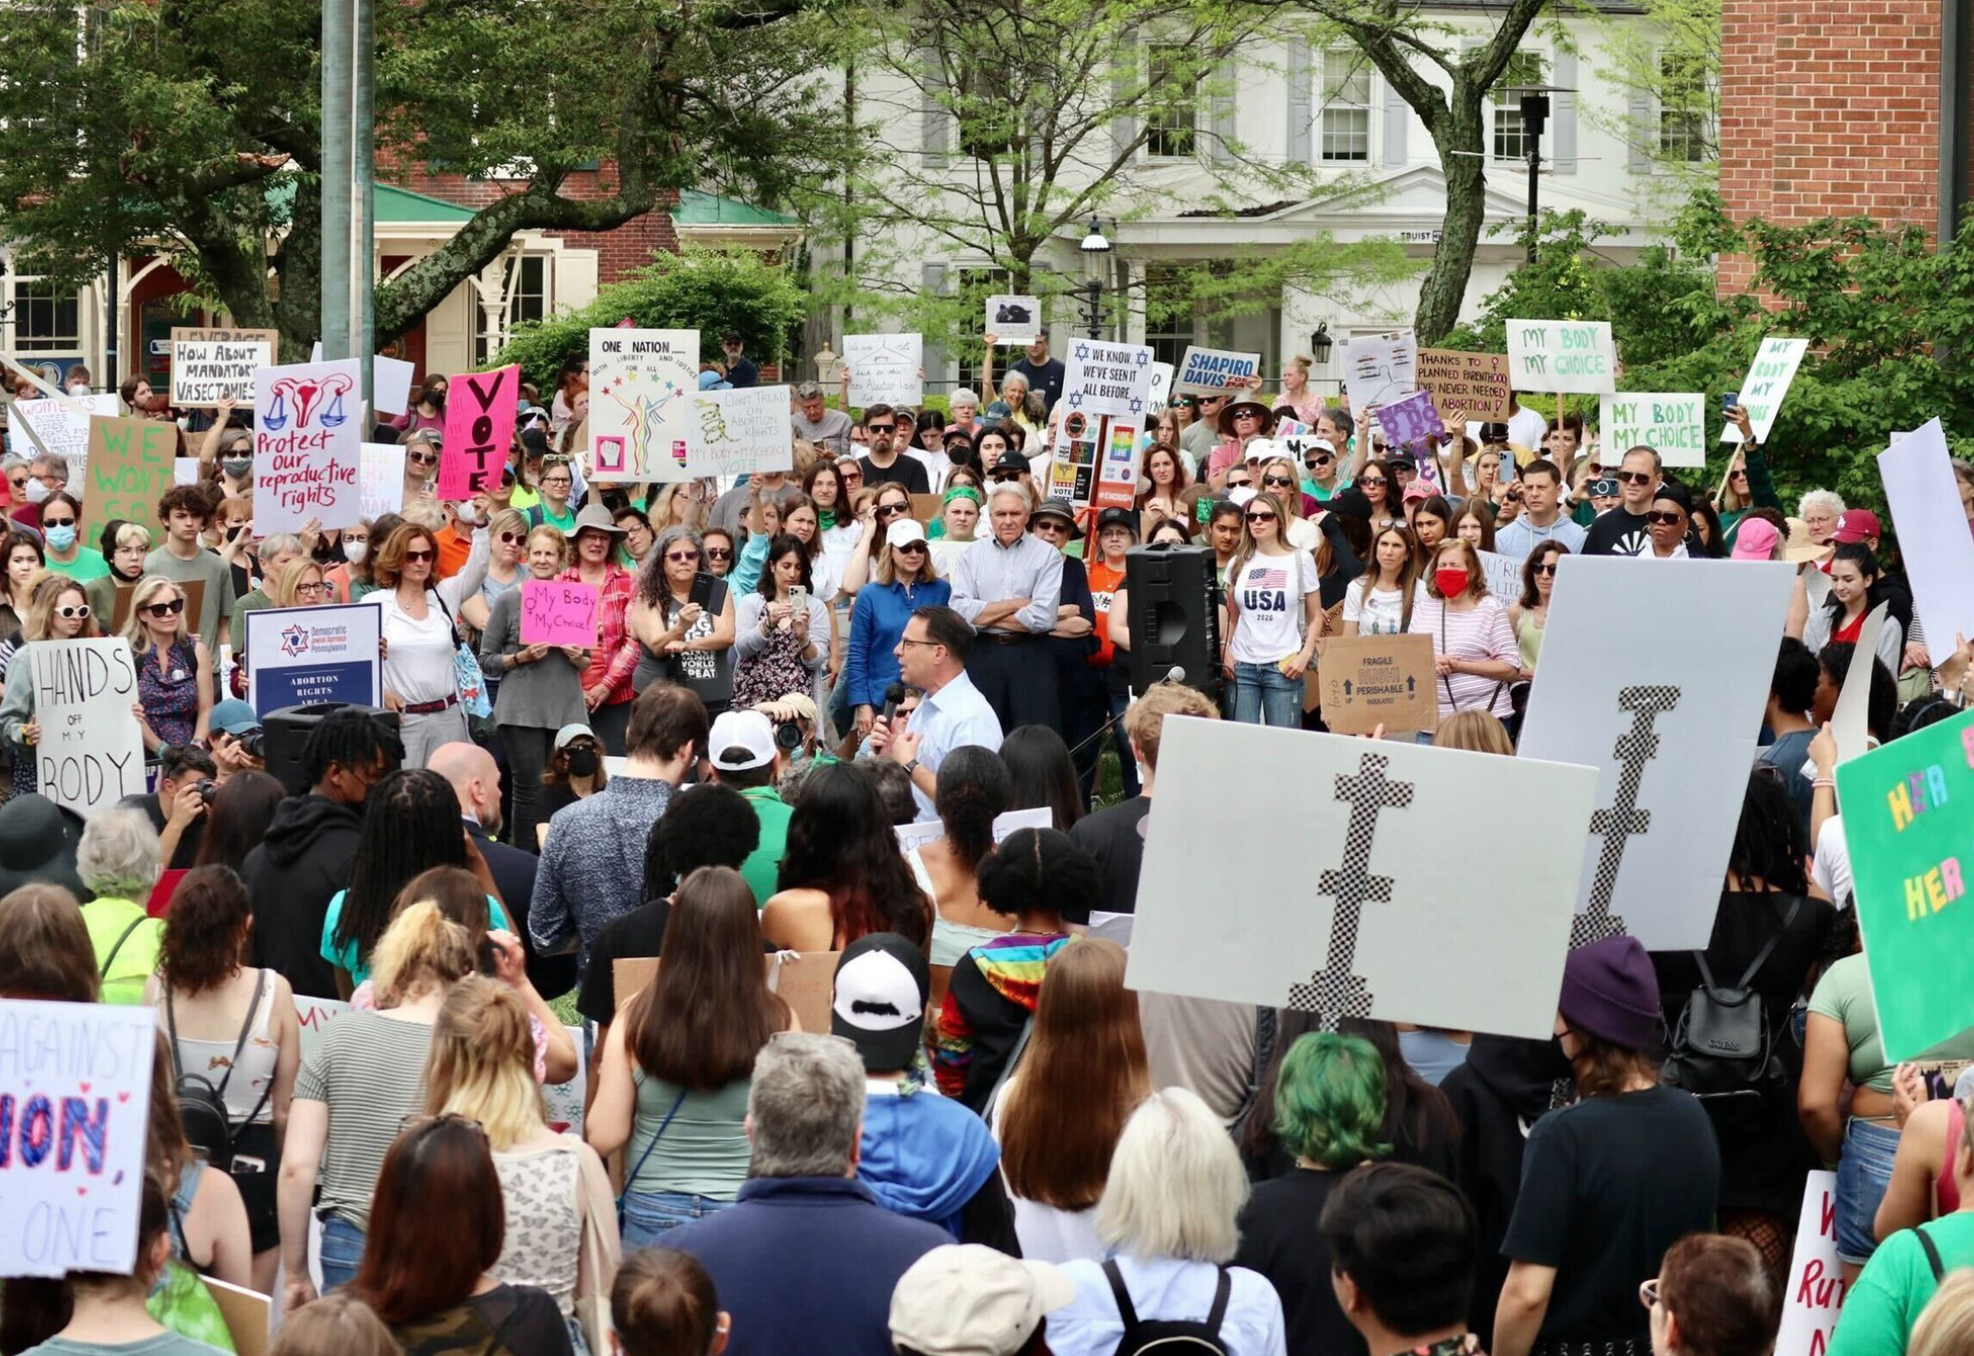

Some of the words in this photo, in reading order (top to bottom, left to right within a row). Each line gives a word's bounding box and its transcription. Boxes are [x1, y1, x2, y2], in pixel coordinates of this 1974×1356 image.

[1522, 328, 1547, 348] MY
[1561, 327, 1598, 349] BODY
[178, 344, 207, 361] HOW
[215, 345, 257, 361] ABOUT
[602, 341, 622, 353] ONE
[1769, 341, 1792, 353] MY
[1092, 348, 1104, 361] WE
[1106, 351, 1132, 365] KNOW.
[1188, 353, 1253, 377] SHAPIRO
[1418, 353, 1461, 365] THANKS
[1467, 357, 1481, 366] TO
[1523, 354, 1547, 374] MY
[1554, 354, 1606, 375] CHOICE
[186, 363, 258, 378] MANDATORY
[592, 363, 608, 377] WITH
[617, 355, 644, 363] LIBERTY
[675, 359, 698, 380] JUSTICE
[1083, 365, 1107, 380] WE'VE
[1109, 368, 1128, 381] SEEN
[1130, 370, 1137, 383] IT
[1418, 367, 1459, 380] PLANNED
[1754, 361, 1789, 377] BODY
[1183, 369, 1226, 388] DAVIS
[176, 381, 255, 401] VASECTOMIES
[757, 391, 787, 403] TREAD
[1083, 383, 1097, 396] ALL
[1100, 385, 1131, 400] BEFORE.
[1438, 383, 1468, 395] NEVER
[1472, 384, 1506, 398] NEEDED
[1751, 382, 1774, 396] MY
[746, 407, 763, 416] ON
[1612, 402, 1638, 424] MY
[1653, 402, 1695, 424] BODY
[731, 415, 778, 427] ABORTION
[464, 371, 504, 492] VOTE
[744, 427, 780, 437] RIGHTS
[1613, 428, 1639, 450] MY
[1645, 424, 1702, 449] CHOICE
[50, 443, 89, 453] MATTE
[100, 423, 165, 462] WE
[257, 429, 335, 454] Protect
[690, 449, 706, 461] MY
[711, 447, 732, 460] BODY
[740, 446, 755, 457] MY
[755, 445, 786, 457] CHOICE
[273, 453, 309, 471] our
[717, 459, 757, 474] VOTE
[260, 457, 356, 496] reproductive
[282, 483, 336, 514] rights
[1054, 488, 1072, 496] VOTE
[104, 499, 148, 521] GO
[534, 587, 556, 612] My
[563, 589, 596, 626] Body
[1244, 590, 1286, 612] USA
[535, 613, 553, 636] My
[1362, 656, 1393, 666] FRAGILE
[37, 646, 133, 708] HANDS
[291, 675, 339, 686] ABORTION
[1358, 667, 1400, 684] RUSH!
[297, 687, 333, 697] RIGHTS
[1356, 685, 1404, 695] PERISHABLE
[1366, 698, 1394, 706] INSULATED
[67, 713, 83, 726] OFF
[62, 731, 85, 742] MY
[42, 751, 132, 805] BODY
[1887, 764, 1948, 832] HER
[1904, 857, 1965, 921] HER
[1707, 1039, 1741, 1051] GUESS
[22, 1200, 118, 1265] ONE
